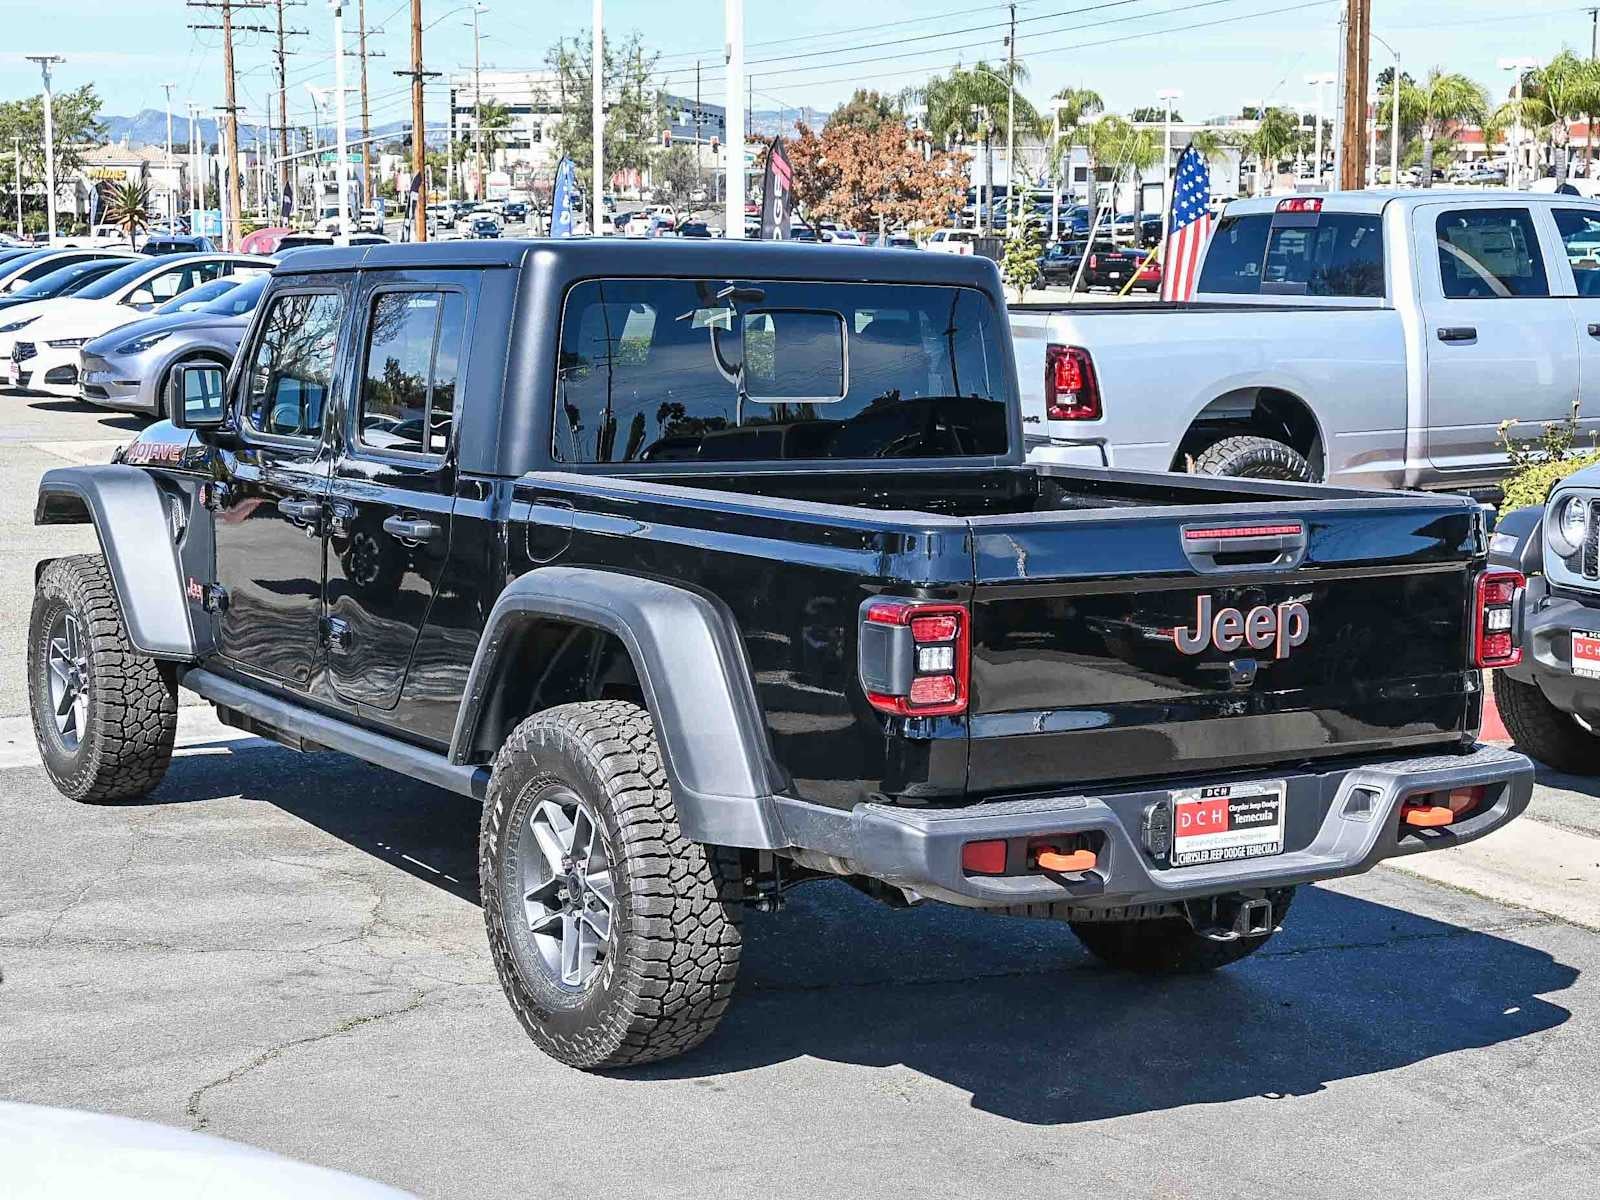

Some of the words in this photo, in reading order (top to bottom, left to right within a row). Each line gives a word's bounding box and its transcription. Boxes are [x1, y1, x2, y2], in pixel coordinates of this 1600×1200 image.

[128, 443, 181, 461] MOJAVE
[1174, 594, 1310, 659] Jeep
[1206, 787, 1227, 798] DCH
[1228, 803, 1249, 812] Chrysler
[1249, 802, 1261, 810] Jeep
[1261, 800, 1279, 809] Dodge
[1181, 809, 1222, 828] DCH
[1234, 810, 1273, 824] Temecula
[1179, 851, 1209, 864] CHRYSLER
[1209, 849, 1224, 860] JEEP
[1224, 847, 1246, 858] DODGE
[1246, 843, 1278, 856] TEMECULA
